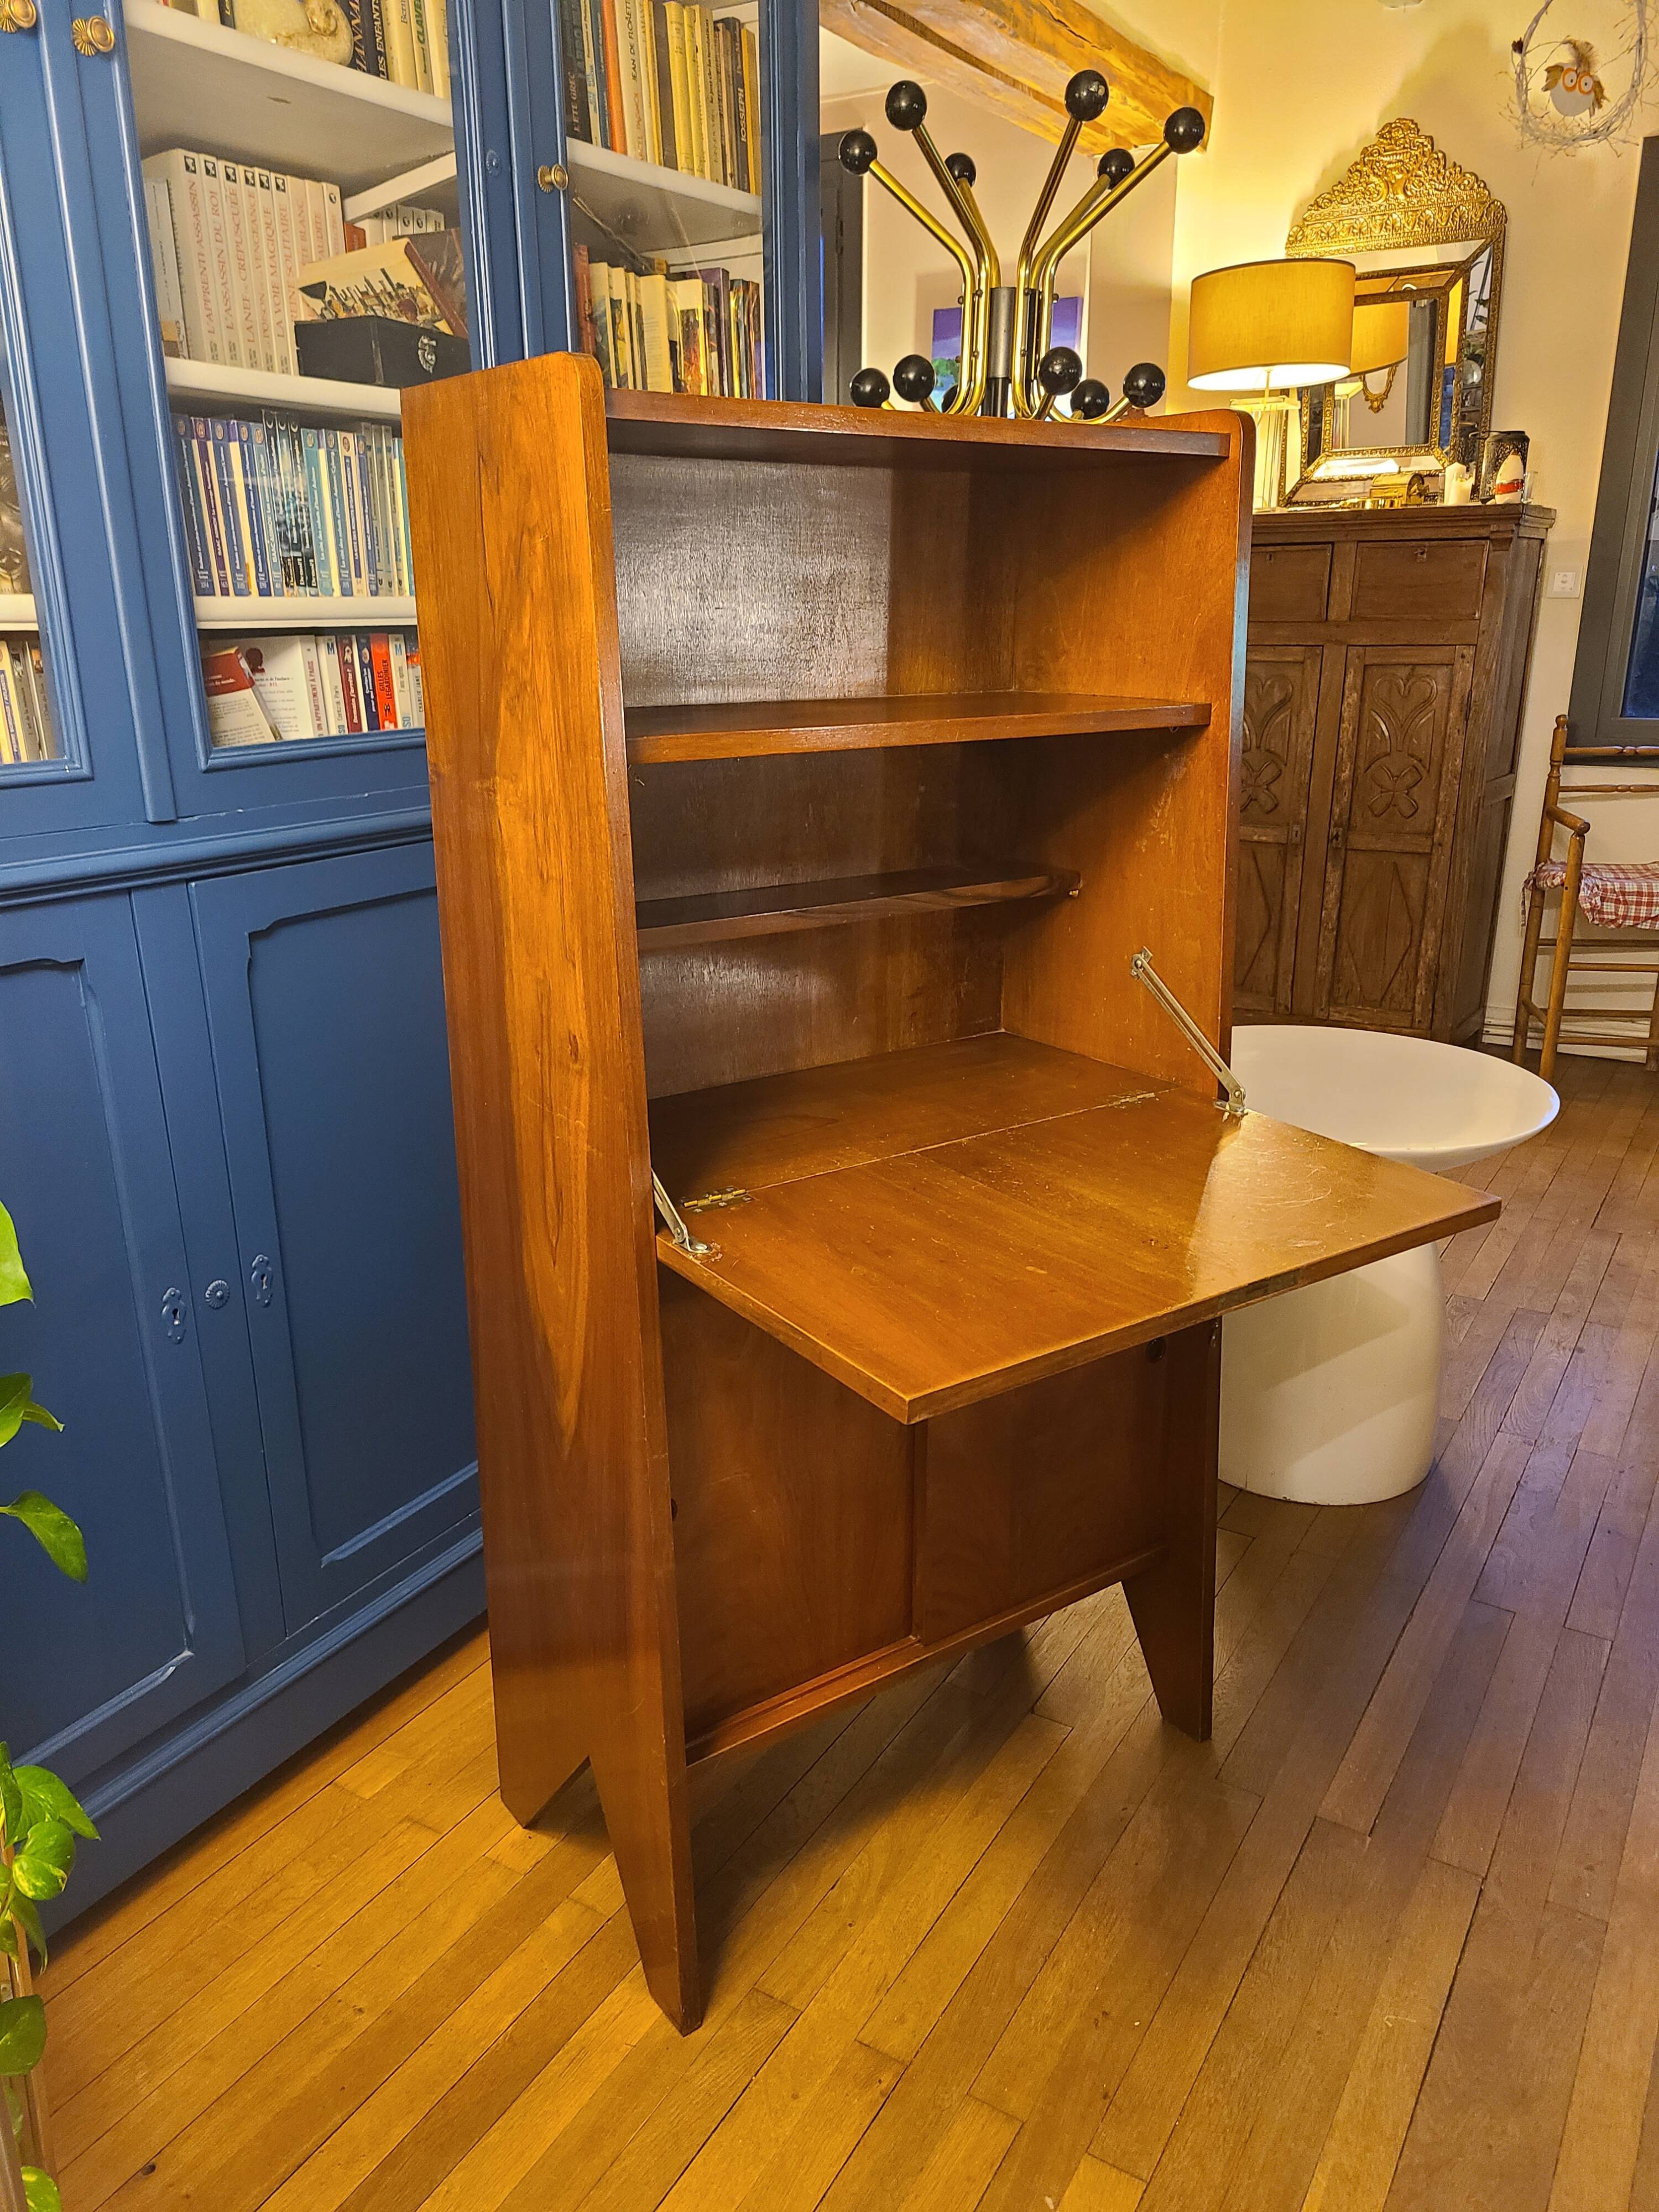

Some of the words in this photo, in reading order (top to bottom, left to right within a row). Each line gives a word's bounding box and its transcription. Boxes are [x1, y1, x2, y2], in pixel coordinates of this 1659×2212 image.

[625, 0, 634, 40] FLORETT
[378, 56, 387, 79] LES
[629, 43, 635, 55] DE
[188, 180, 204, 249] ASSASSIN
[210, 191, 220, 216] ROI
[213, 221, 222, 243] DU
[248, 189, 262, 270] VENGEANCE
[263, 206, 278, 276] MAGIQUE
[279, 203, 291, 275] SOLITAIRE
[197, 252, 215, 335] L'APPRENTI
[217, 248, 234, 330] L'ASSASSIN
[242, 294, 252, 323] NEF
[272, 281, 282, 314] VOIE
[246, 325, 255, 342] LA
[276, 320, 285, 338] LA
[382, 659, 392, 699] LEGARDINIER
[311, 682, 321, 722] APPARTEMENT
